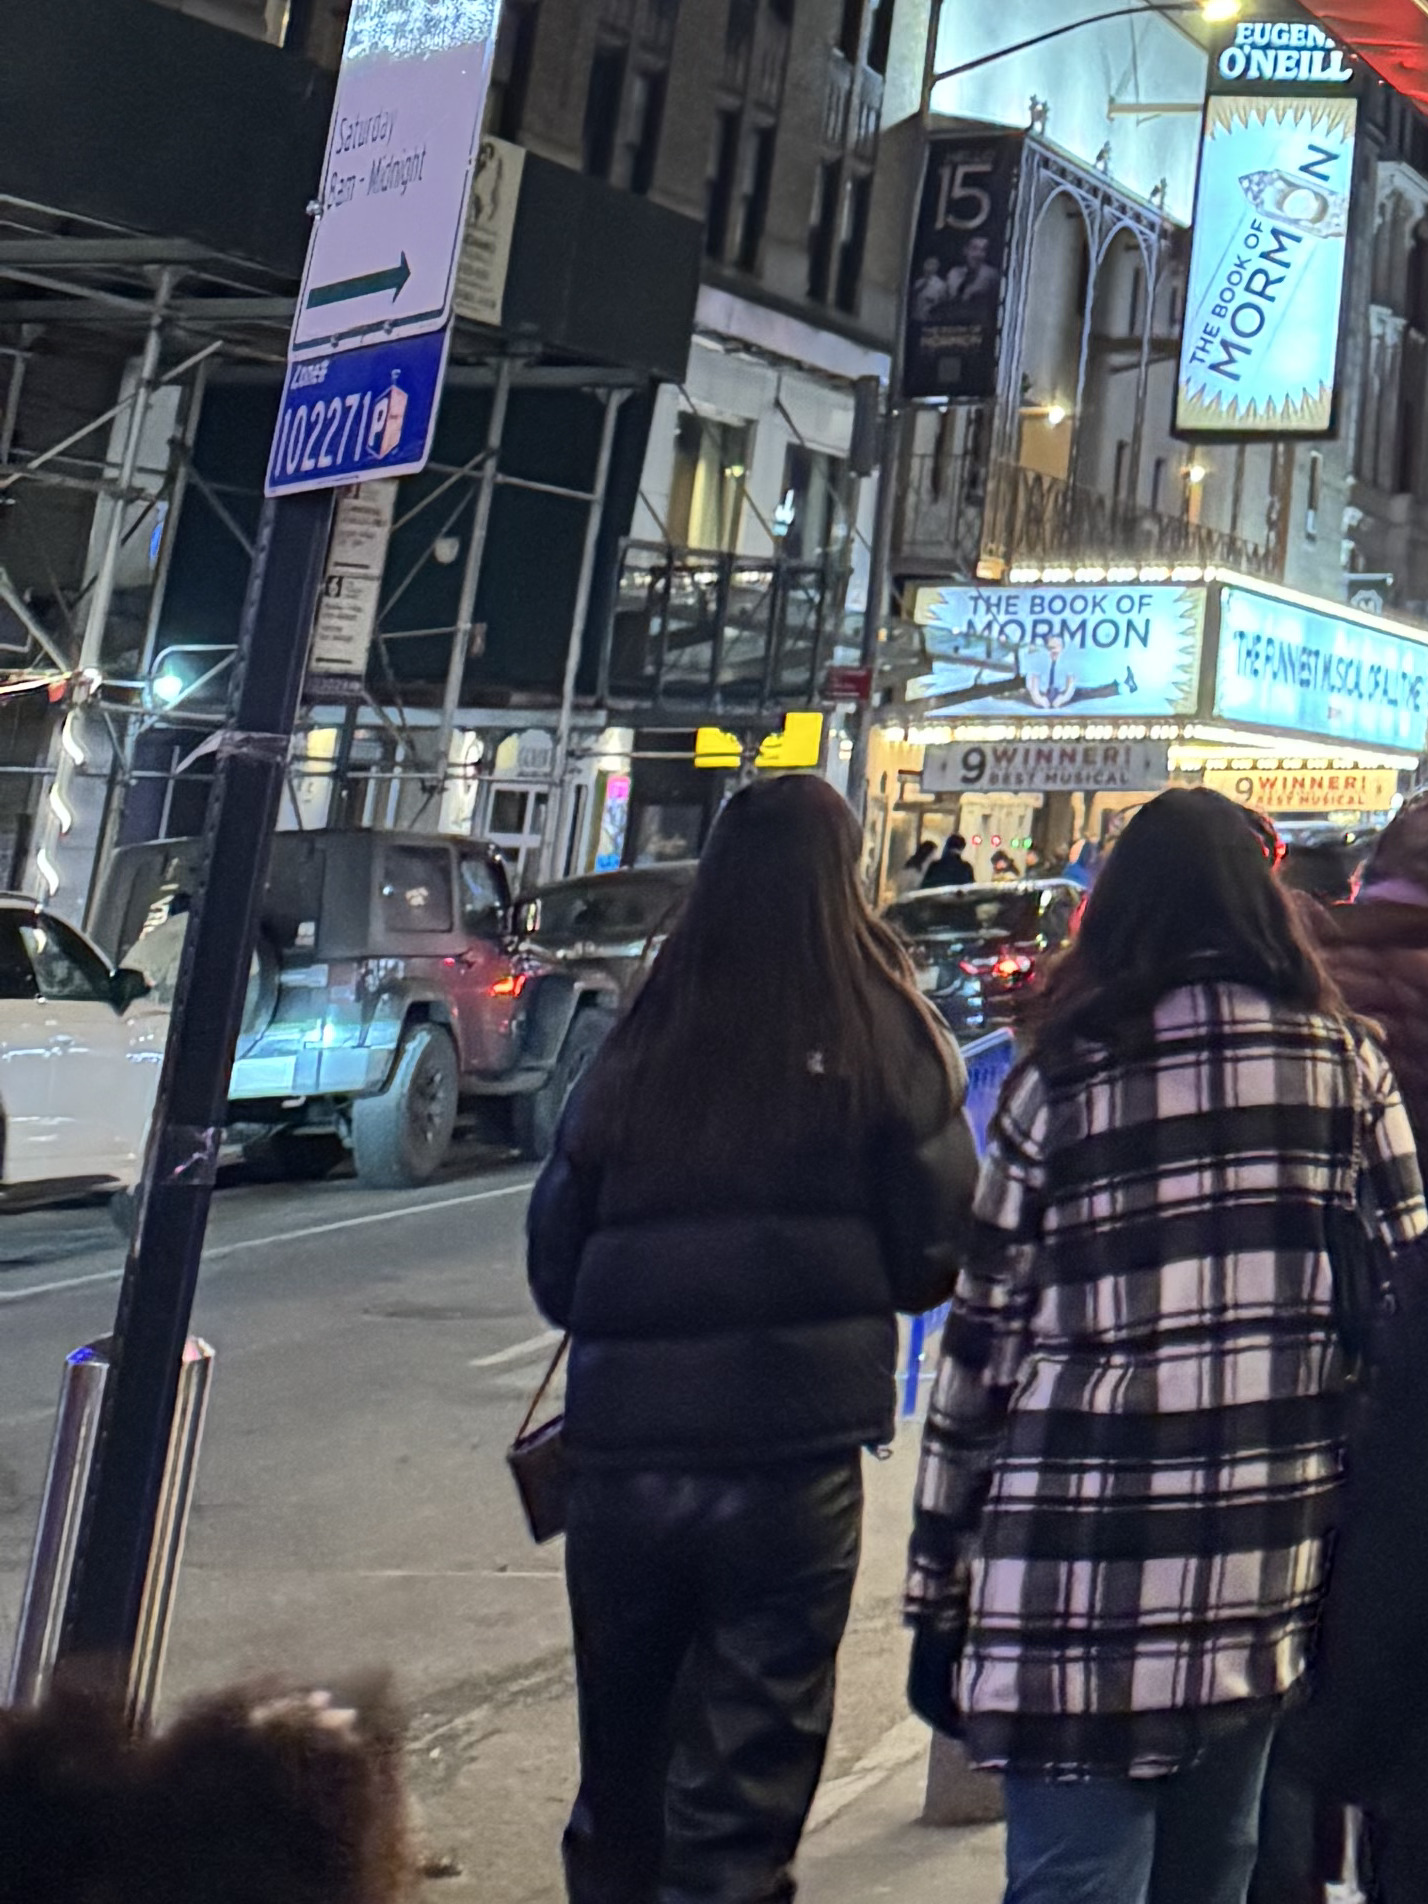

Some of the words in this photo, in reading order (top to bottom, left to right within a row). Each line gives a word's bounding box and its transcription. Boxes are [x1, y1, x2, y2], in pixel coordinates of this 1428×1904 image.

[1234, 22, 1338, 48] EUGEN
[1218, 45, 1354, 83] O'NEILL
[334, 107, 398, 156] Saturday
[326, 171, 356, 210] 8am
[366, 145, 428, 198] Midnight
[934, 163, 993, 231] 15
[1207, 142, 1342, 383] MORMON
[1188, 322, 1222, 367] THE
[1211, 253, 1253, 320] BOOK
[1244, 217, 1266, 251] OF
[274, 390, 374, 480] 102271
[967, 594, 1021, 616] THE
[1028, 594, 1108, 616] BOOK
[1114, 593, 1154, 616] OF
[964, 617, 1152, 650] MORMON
[960, 746, 987, 784] 9
[989, 745, 1131, 767] WINNER!
[988, 770, 1036, 787] BEST
[1043, 769, 1130, 786] MUSICAL
[1235, 776, 1254, 803] 9
[1257, 775, 1367, 790] WINNER!
[1300, 793, 1365, 806] MUSICAL
